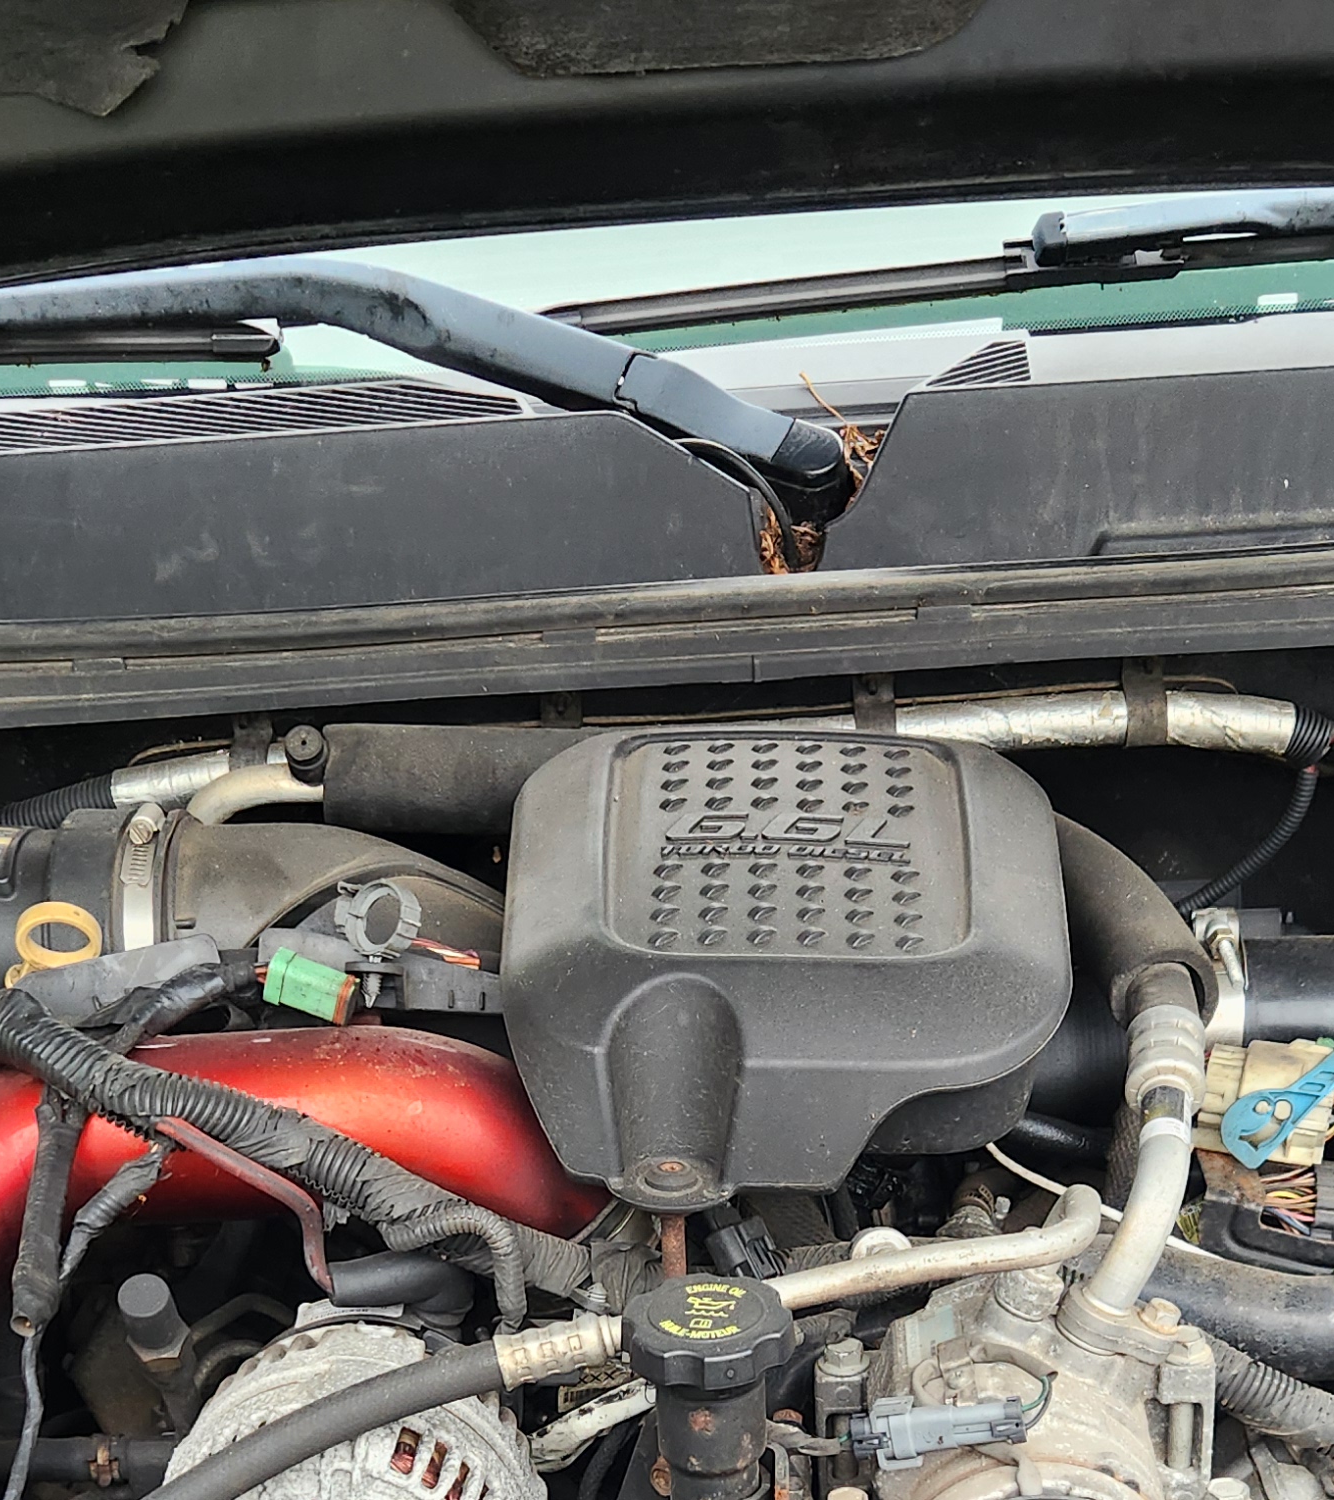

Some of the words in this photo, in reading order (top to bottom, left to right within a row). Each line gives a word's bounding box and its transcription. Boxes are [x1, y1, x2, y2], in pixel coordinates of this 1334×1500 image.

[665, 812, 910, 848] 6.6L
[661, 843, 781, 859] TURBO
[787, 844, 911, 866] DIESEL
[685, 1283, 730, 1294] ENGINE
[728, 1287, 747, 1298] OIL
